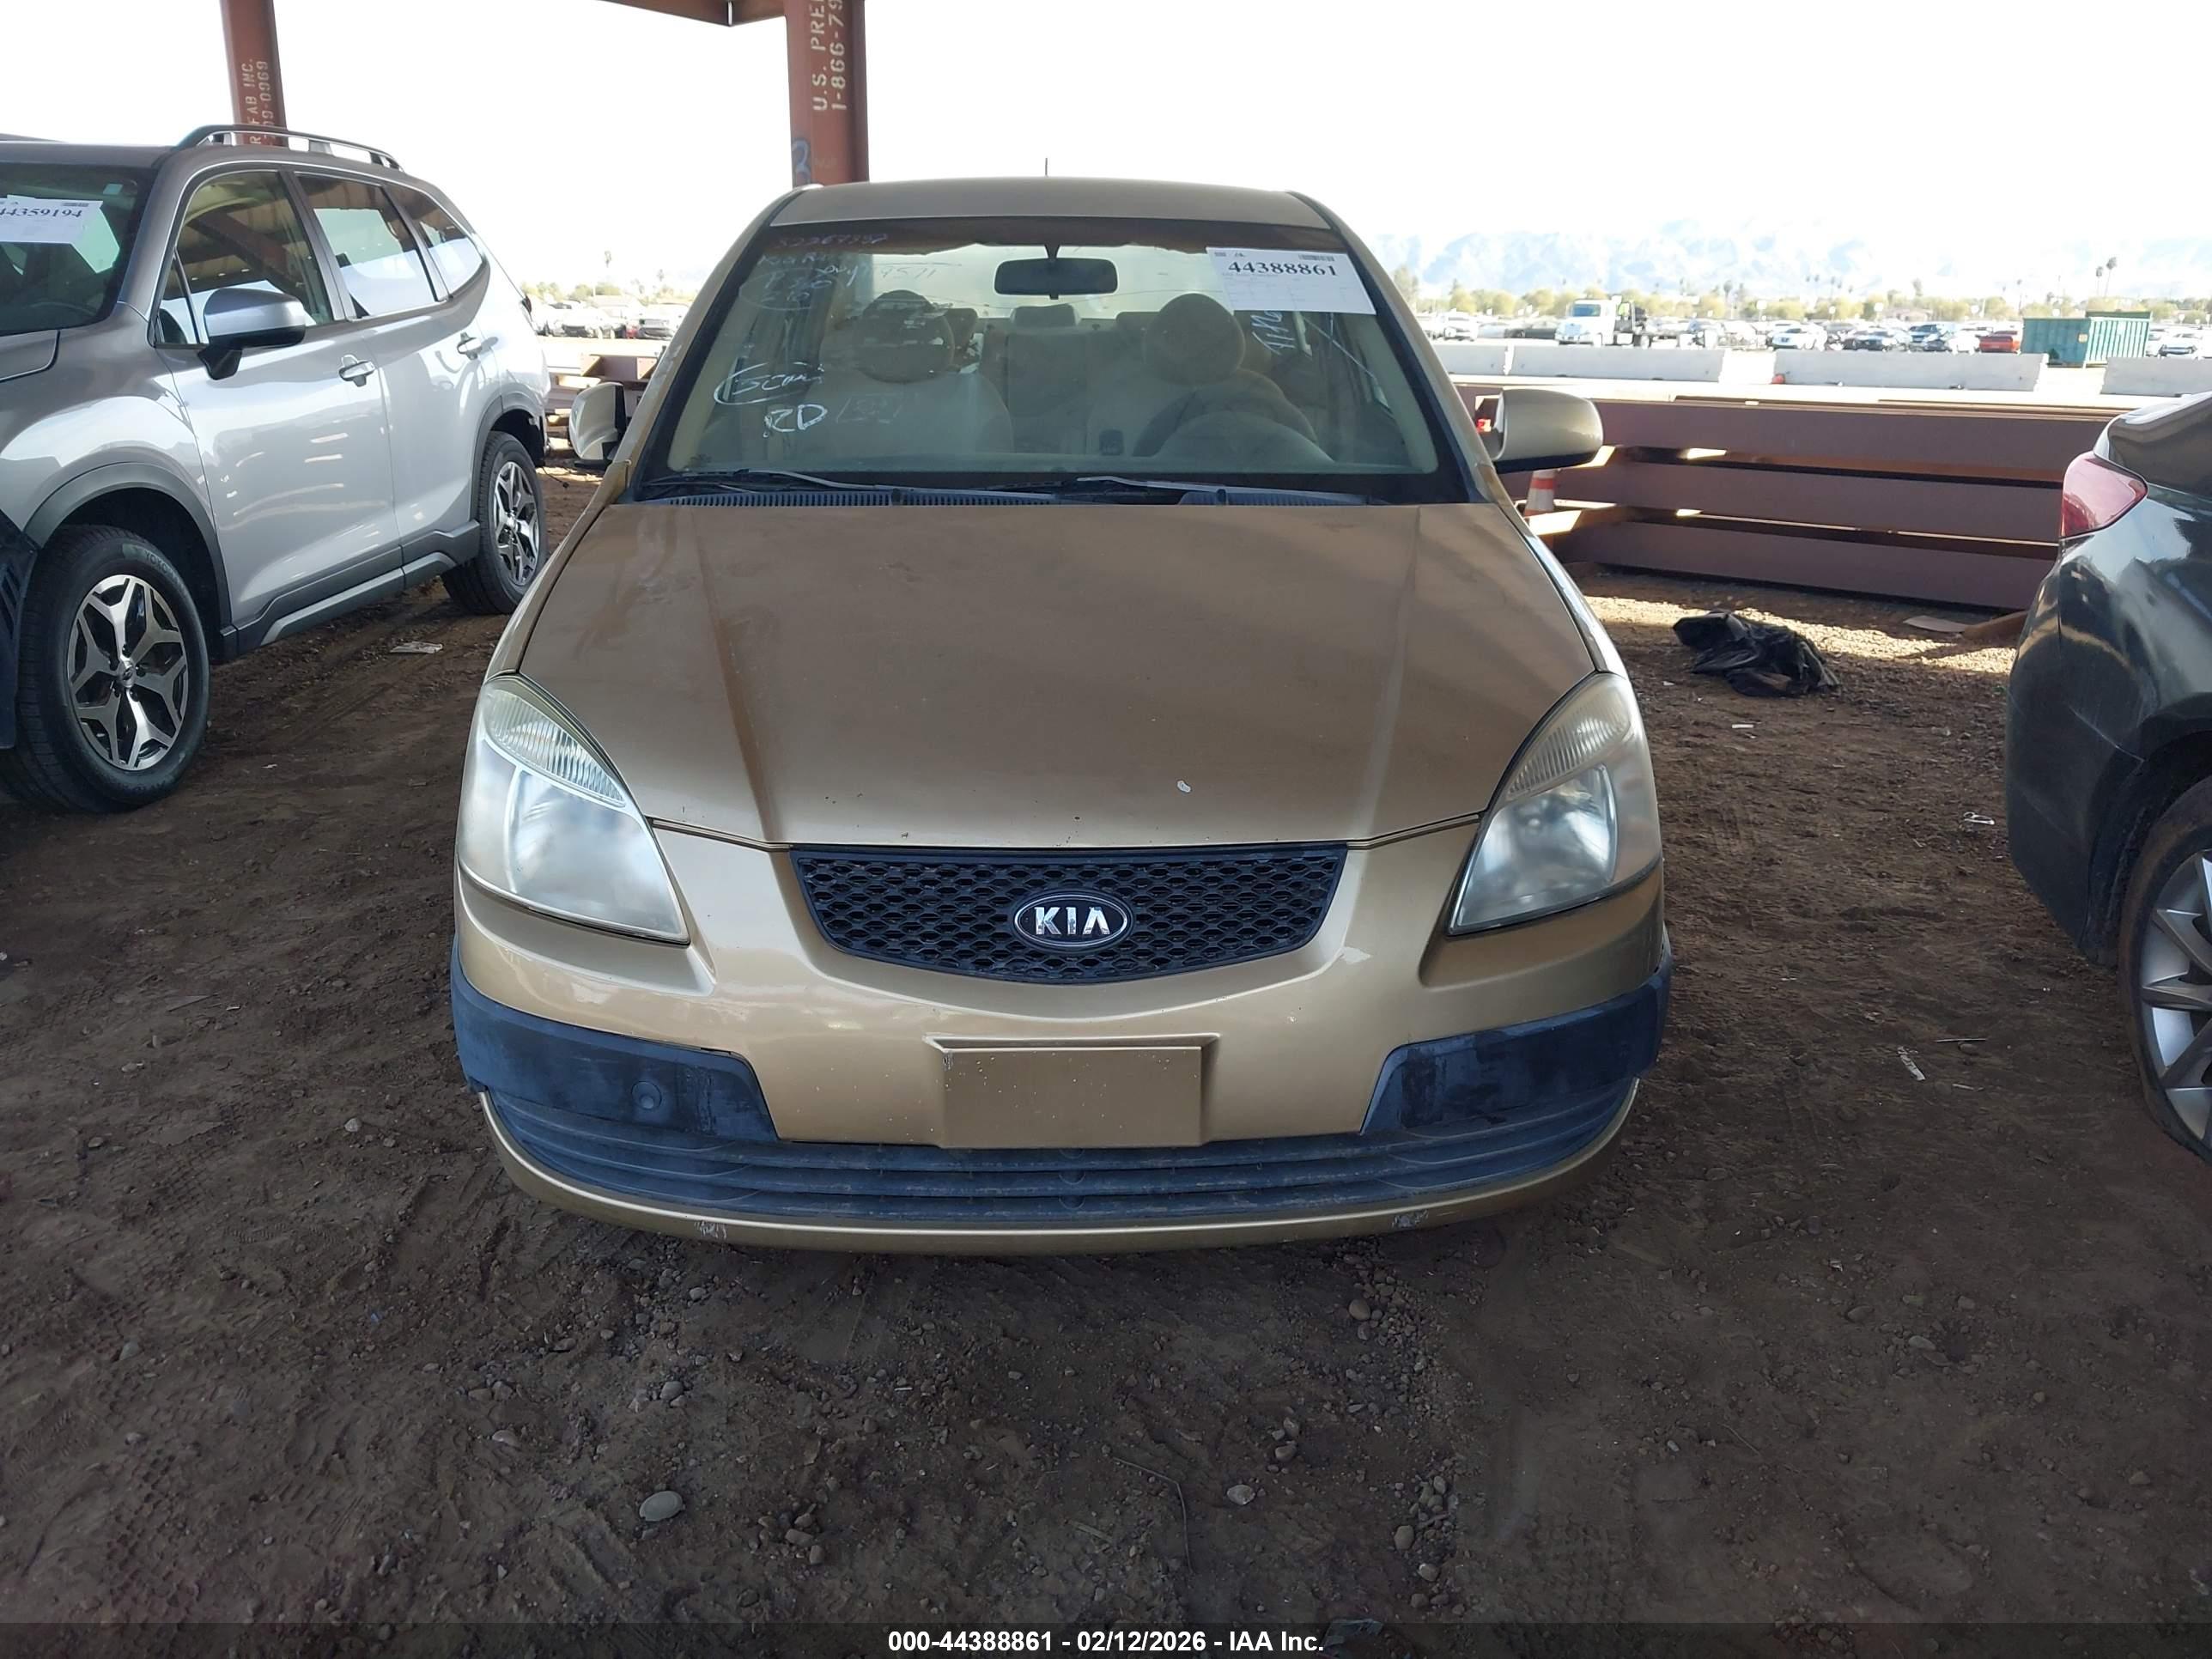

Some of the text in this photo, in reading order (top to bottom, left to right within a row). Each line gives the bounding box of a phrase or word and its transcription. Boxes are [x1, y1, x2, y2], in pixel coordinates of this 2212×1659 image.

[810, 0, 828, 111] U.S. PRE
[246, 95, 262, 144] RFAB
[1228, 261, 1338, 276] 44388861
[1034, 906, 1110, 935] KIA
